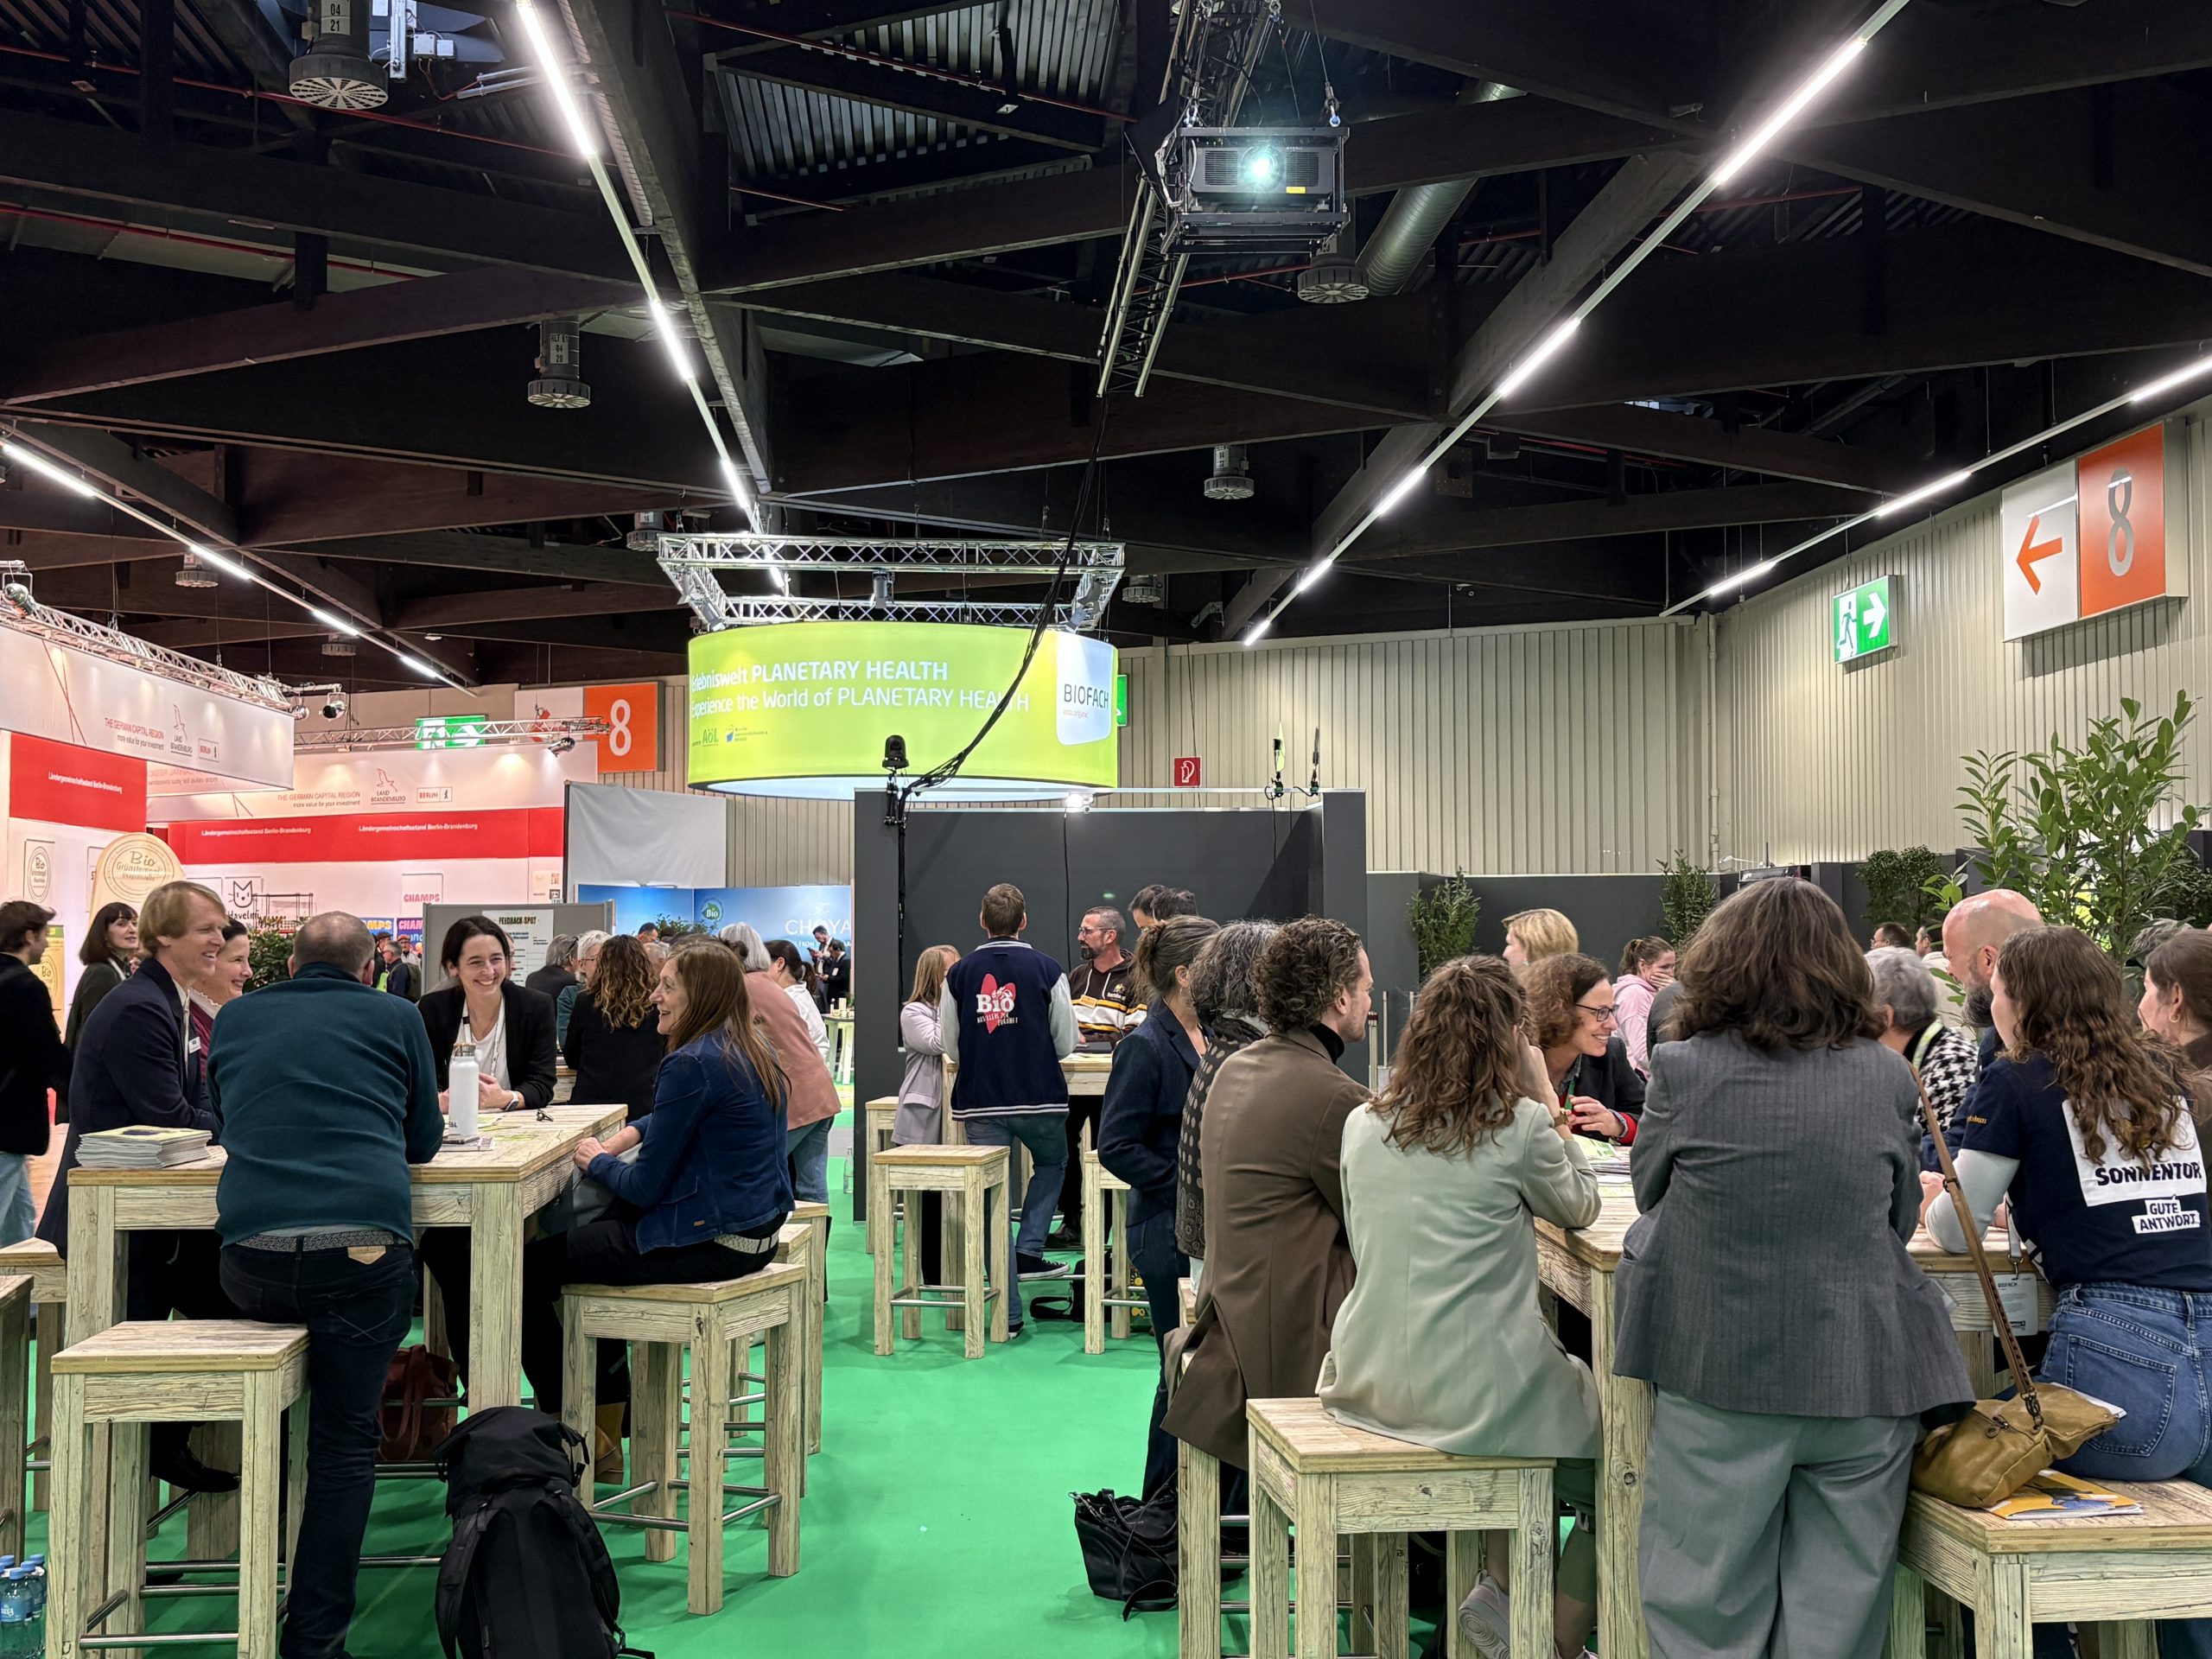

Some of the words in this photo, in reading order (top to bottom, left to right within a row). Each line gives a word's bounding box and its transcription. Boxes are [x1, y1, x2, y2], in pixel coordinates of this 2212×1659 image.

[330, 3, 340, 16] 04
[330, 19, 340, 31] 21
[2107, 467, 2134, 577] 8
[752, 661, 860, 683] PLANETARY
[867, 661, 948, 680] HEALTH
[736, 692, 760, 710] the
[763, 688, 809, 709] World
[814, 687, 833, 707] of
[838, 687, 953, 708] PLANETARY
[1064, 683, 1109, 709] BIOFACH
[609, 698, 632, 756] 8
[130, 851, 156, 867] Bio
[404, 893, 440, 902] CHAMPS
[706, 907, 719, 918] Bio
[2095, 1162, 2202, 1186] SONNENTOR
[2150, 1202, 2178, 1215] GUTE
[2139, 1213, 2196, 1231] ANTWORT
